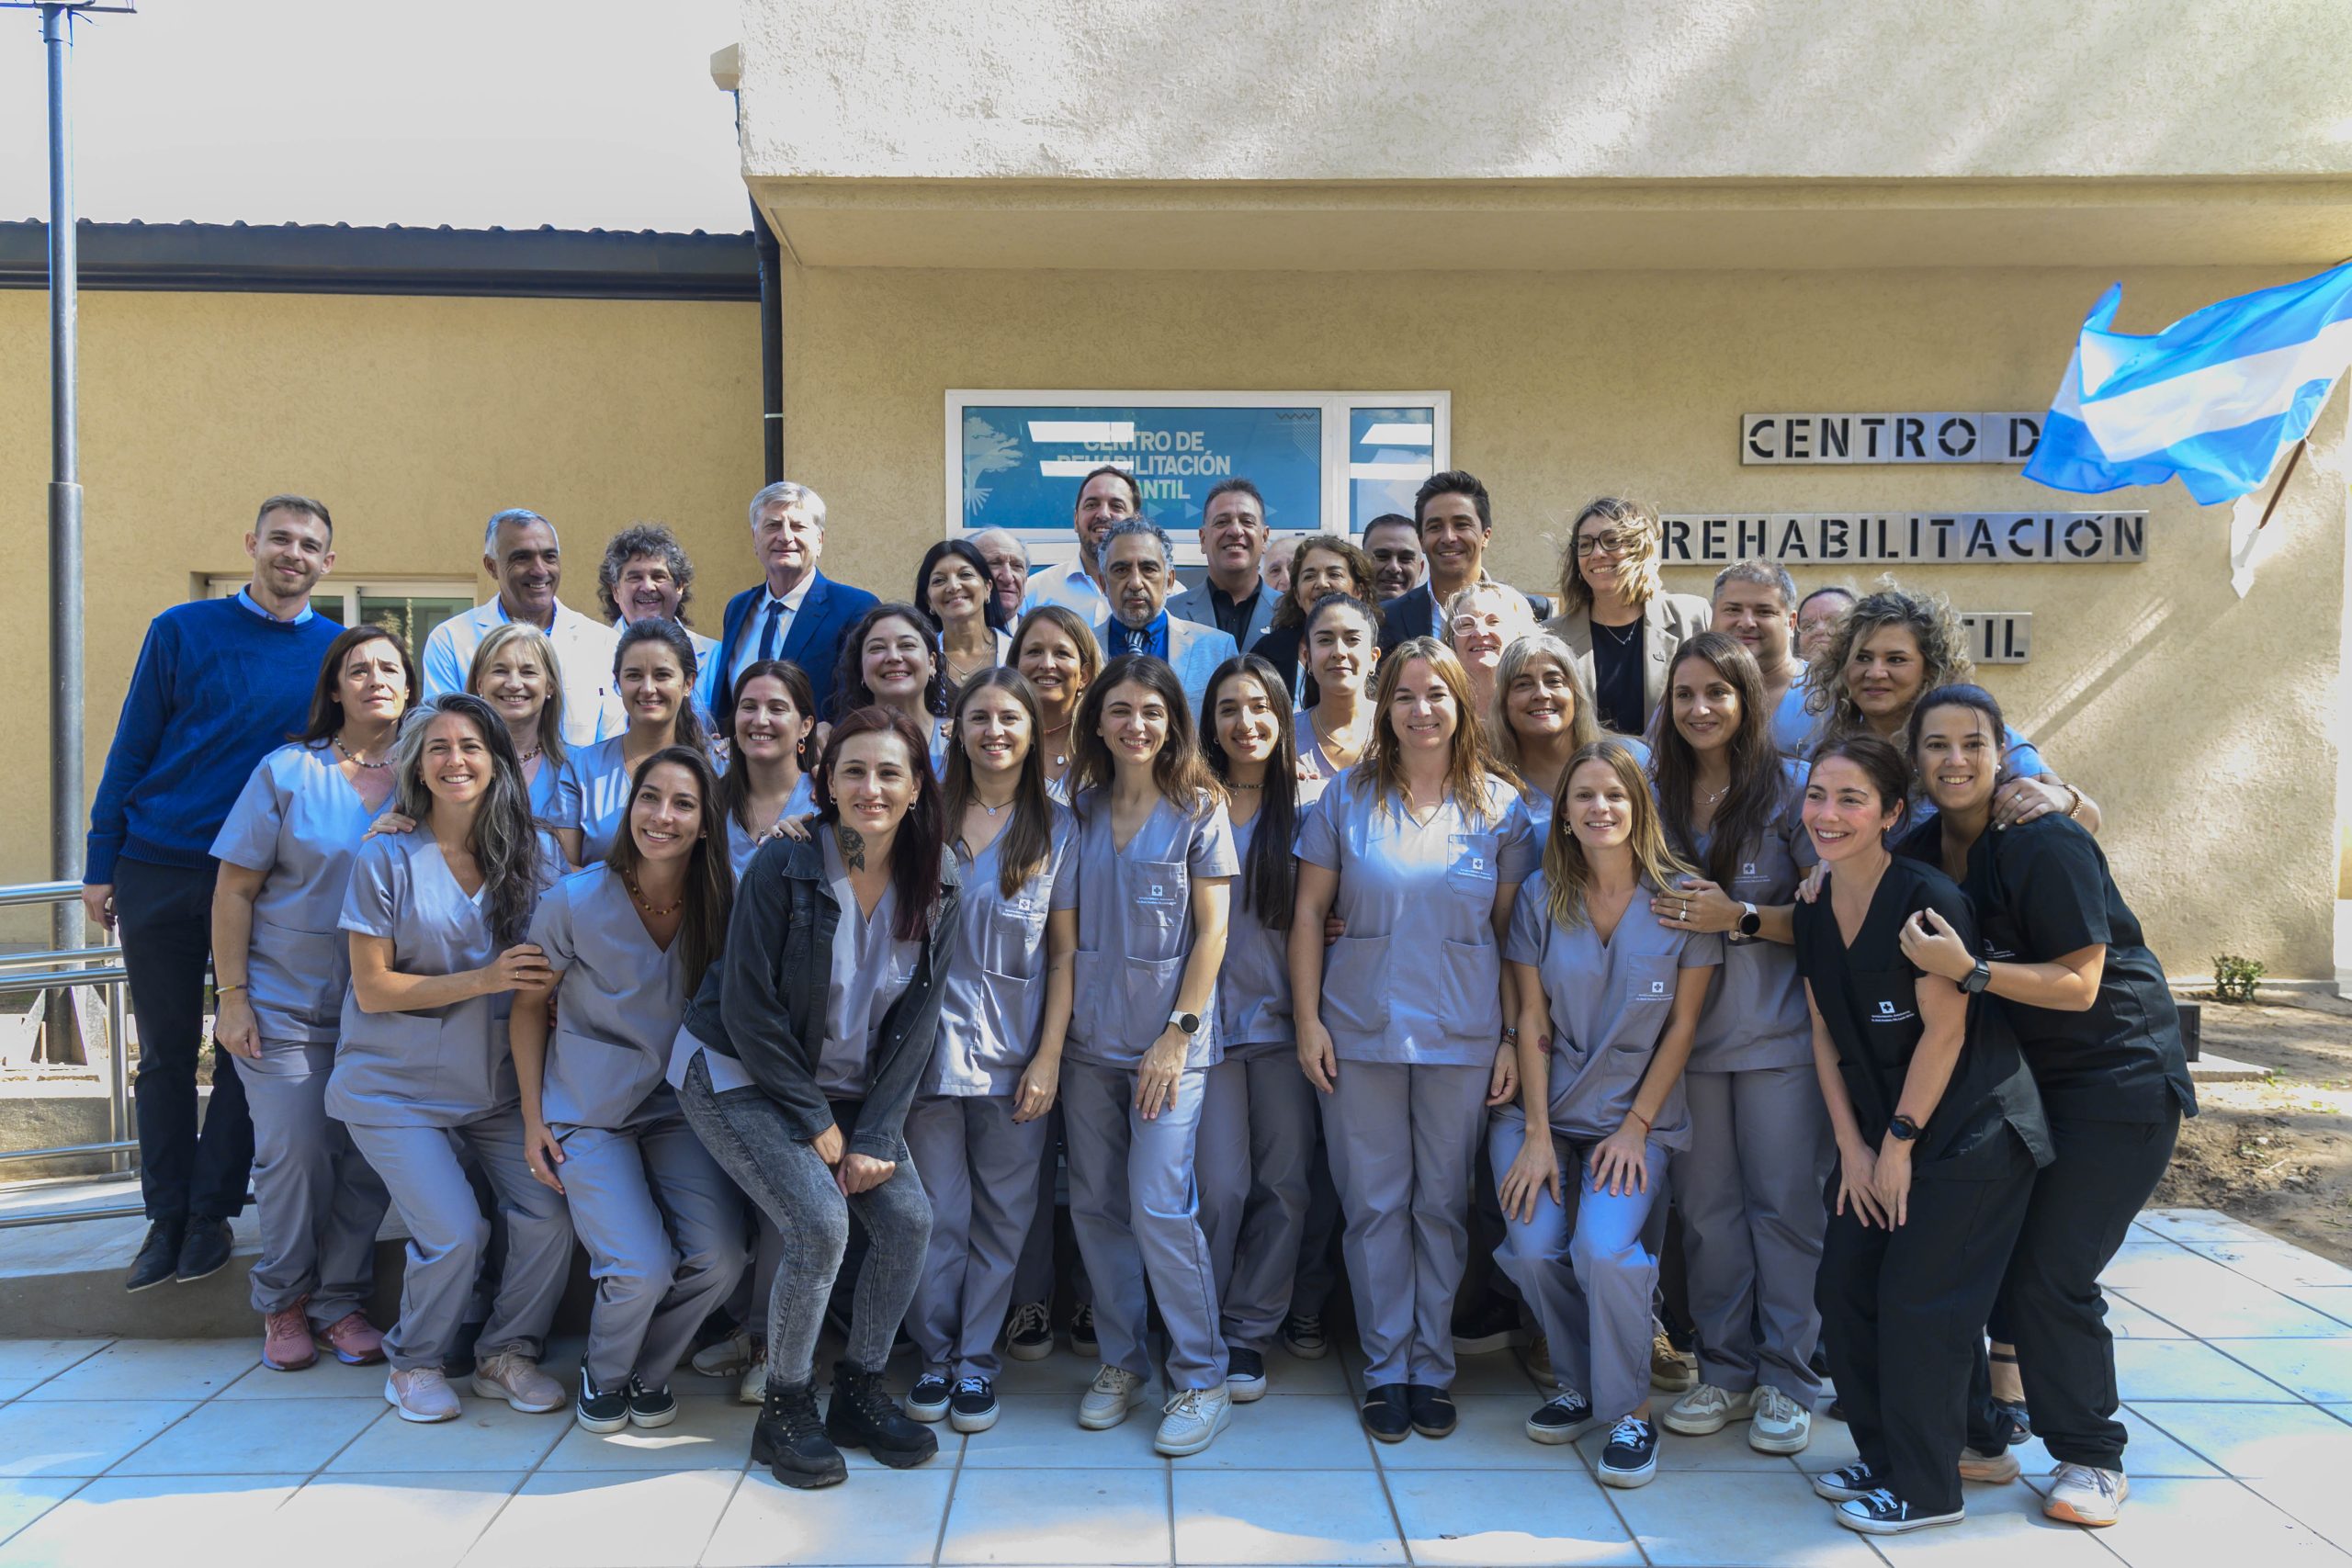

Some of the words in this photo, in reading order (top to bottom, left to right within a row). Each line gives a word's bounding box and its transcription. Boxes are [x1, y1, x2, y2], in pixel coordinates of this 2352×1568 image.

[1176, 432, 1204, 452] DE
[1748, 418, 1977, 458] CENTRO
[2008, 418, 2040, 457] D
[1661, 515, 2143, 559] REHABILITACIÓN
